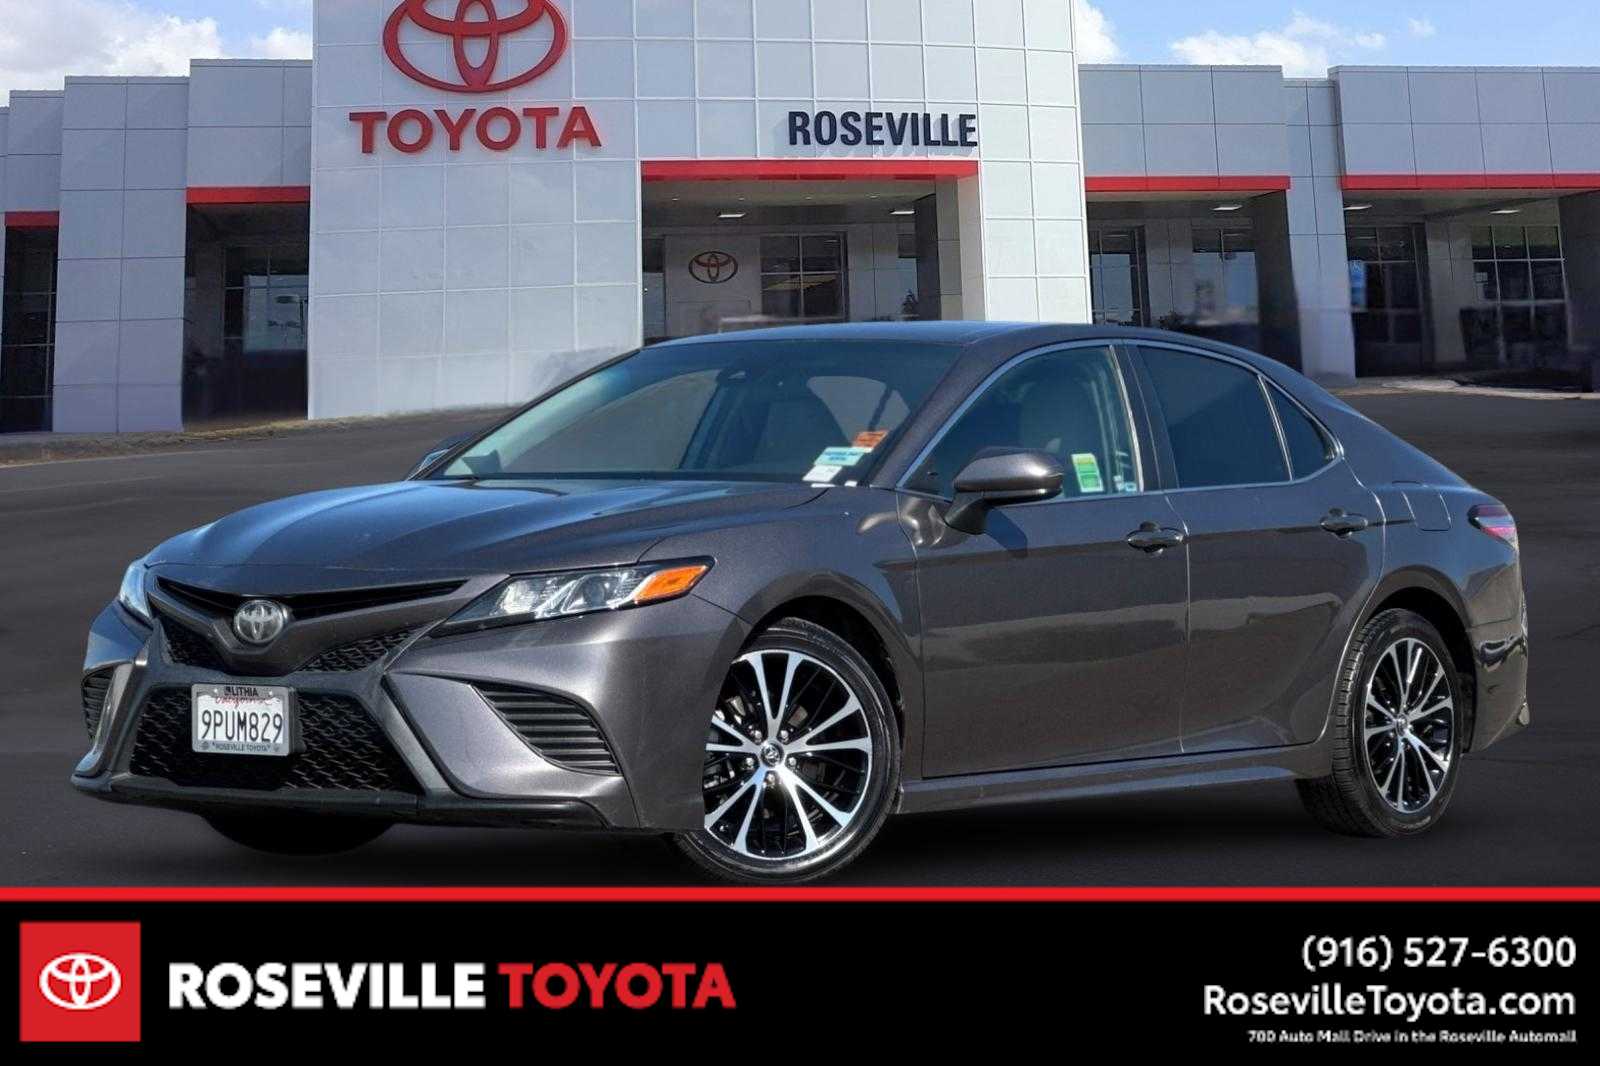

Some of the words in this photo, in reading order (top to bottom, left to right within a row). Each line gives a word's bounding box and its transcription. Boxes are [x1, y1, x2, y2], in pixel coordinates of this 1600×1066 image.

[349, 106, 602, 154] TOYOTA
[788, 110, 978, 147] ROSEVILLE
[202, 709, 283, 743] 9PUM829
